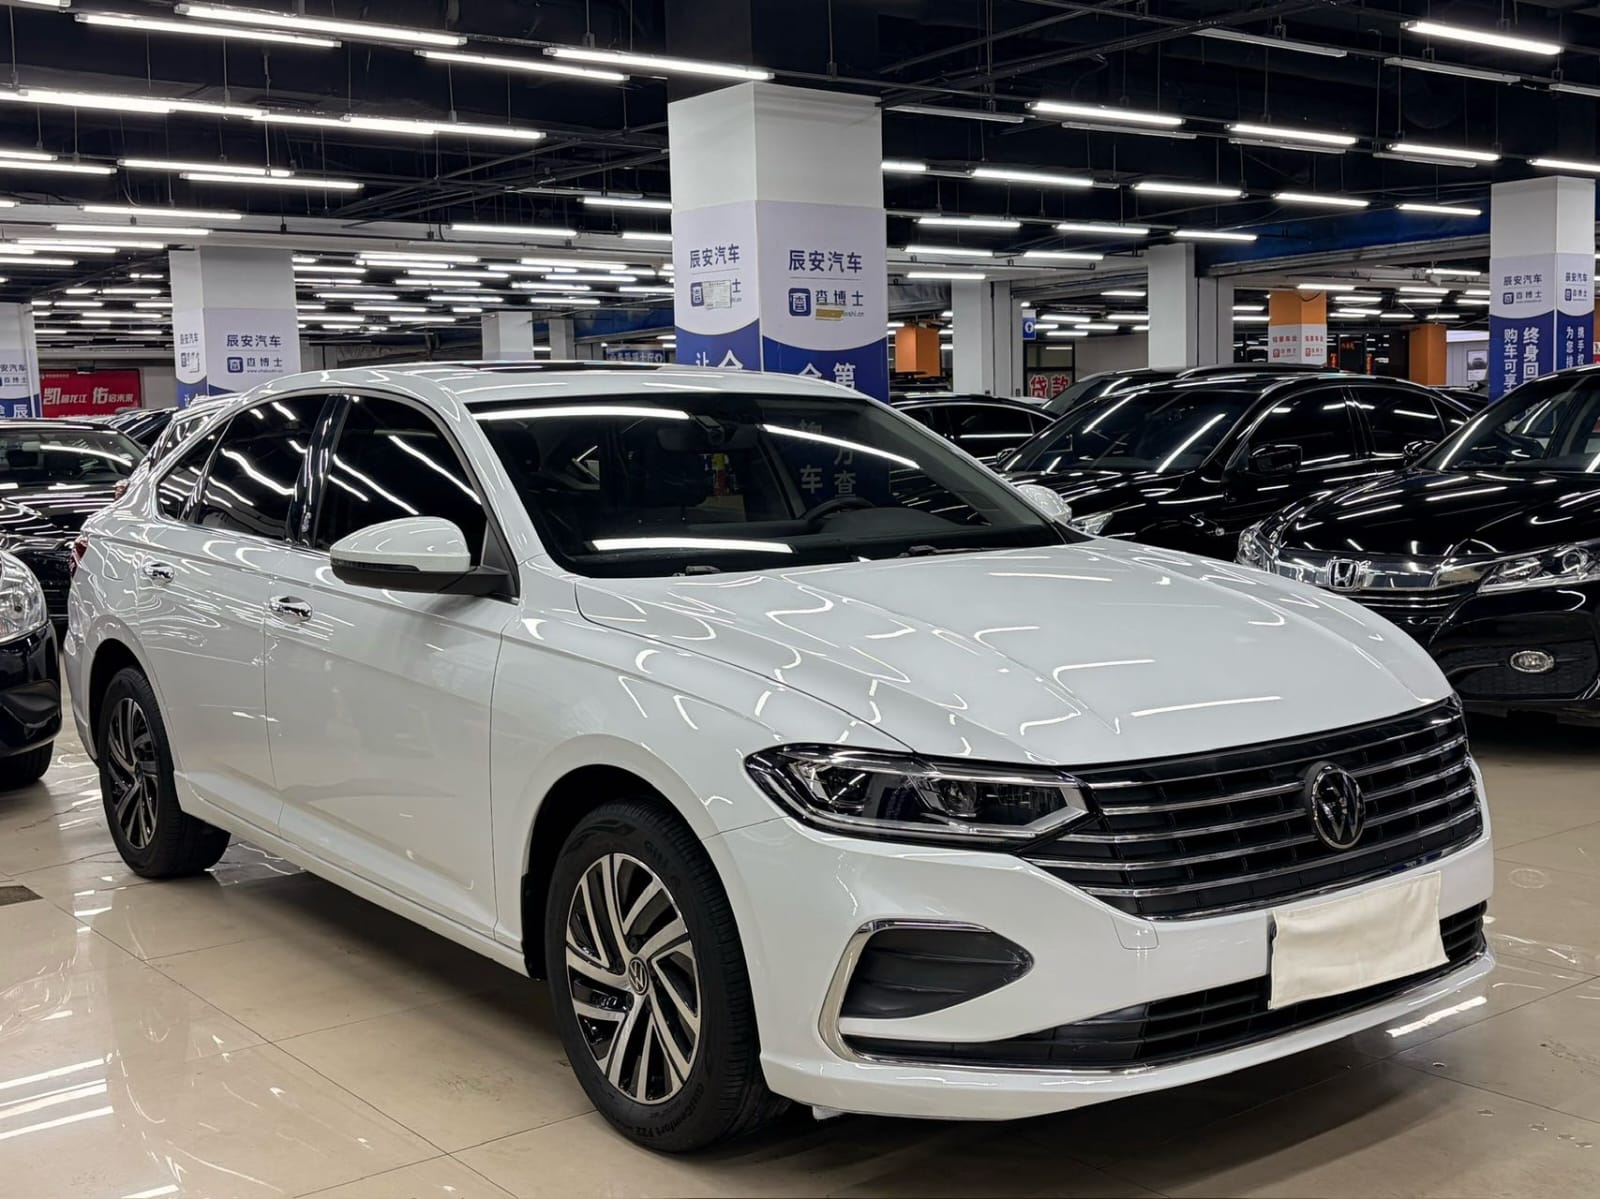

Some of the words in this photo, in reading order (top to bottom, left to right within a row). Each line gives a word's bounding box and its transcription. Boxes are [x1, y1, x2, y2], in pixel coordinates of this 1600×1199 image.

[690, 243, 741, 269] 辰安汽车
[788, 250, 863, 273] 辰安汽车
[1503, 273, 1542, 287] 辰安汽车
[226, 334, 282, 348] 辰安汽车
[1503, 328, 1518, 393] 购车可享
[1523, 326, 1540, 384] 终身回
